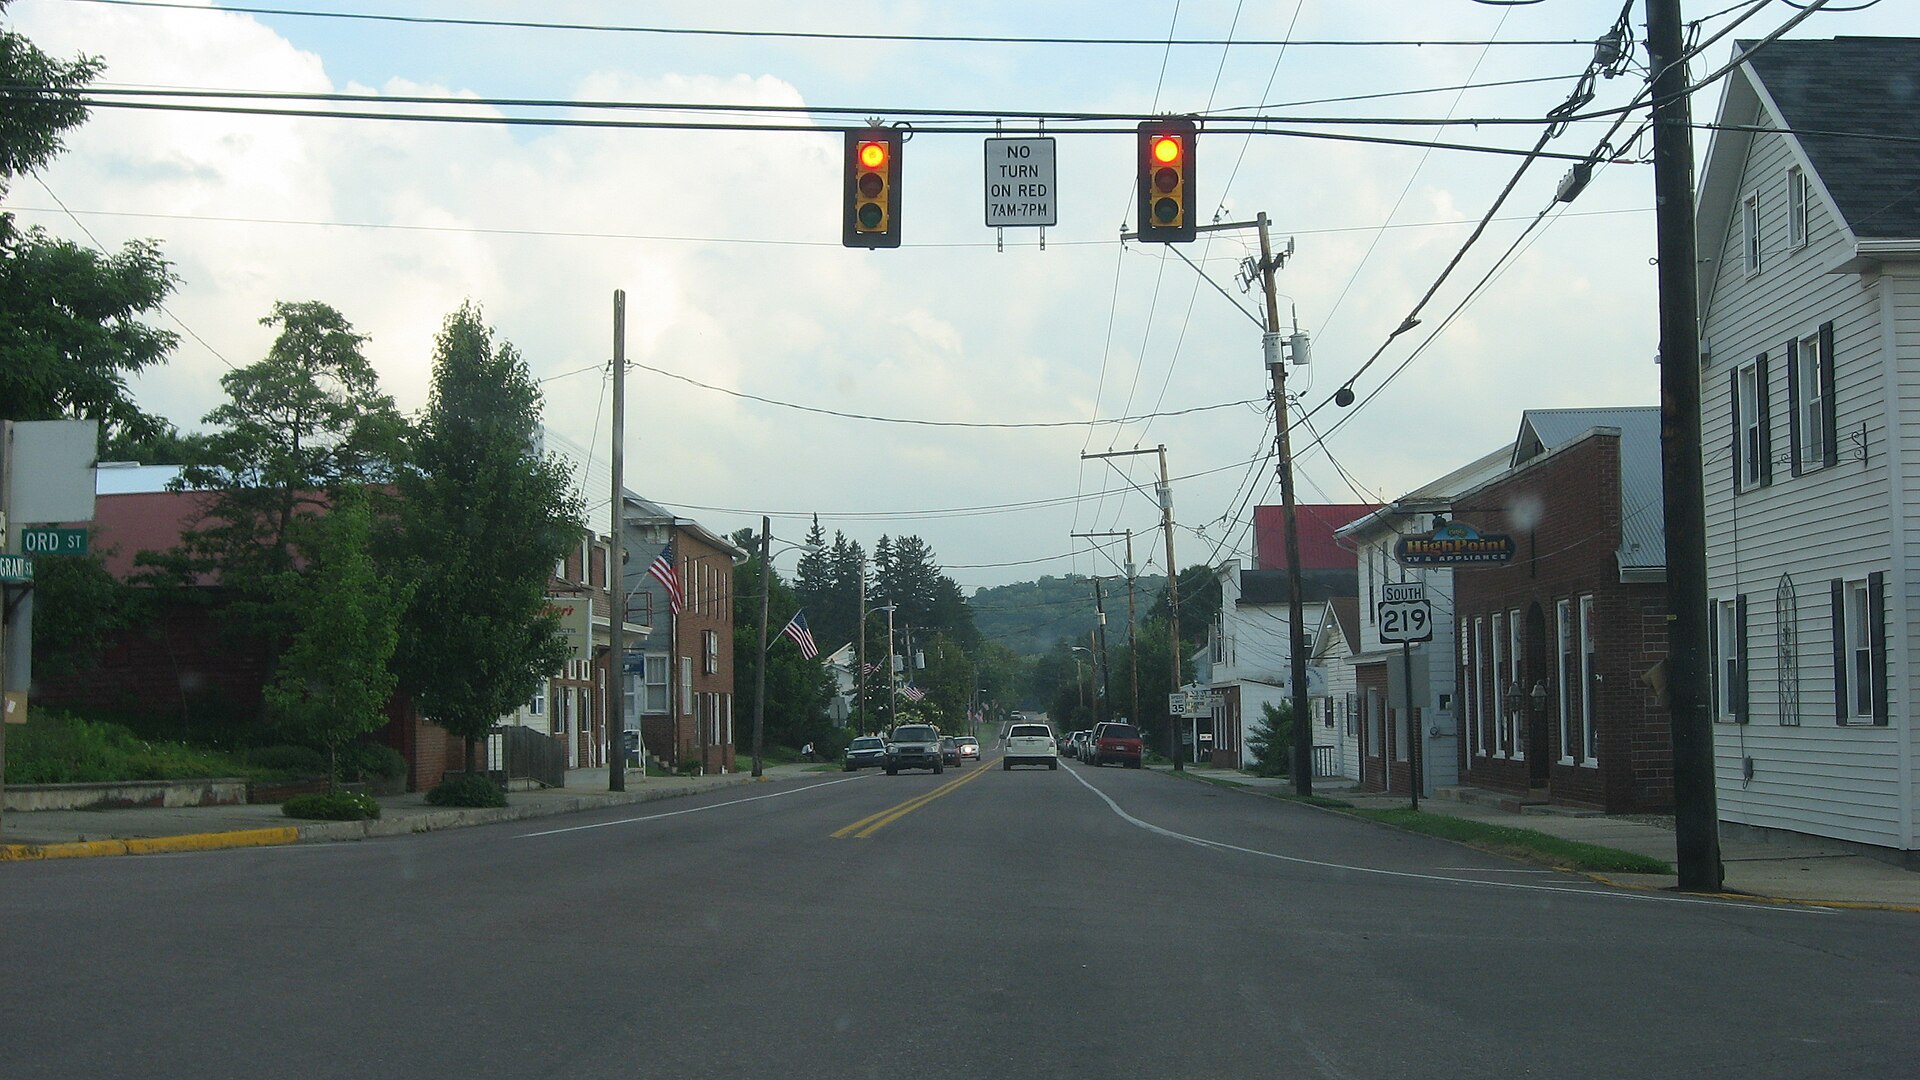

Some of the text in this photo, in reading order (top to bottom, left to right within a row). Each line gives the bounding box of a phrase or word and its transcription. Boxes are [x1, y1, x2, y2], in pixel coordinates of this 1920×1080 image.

[1007, 145, 1031, 159] NO
[1000, 164, 1038, 178] TURN
[991, 184, 1047, 197] ON RED
[991, 203, 1047, 217] 7AM-7PM
[26, 532, 81, 551] ORD ST
[1438, 553, 1507, 562] APPLIANCE
[1386, 587, 1422, 600] SOUTH
[1384, 608, 1426, 632] 219
[1171, 704, 1185, 713] 35
